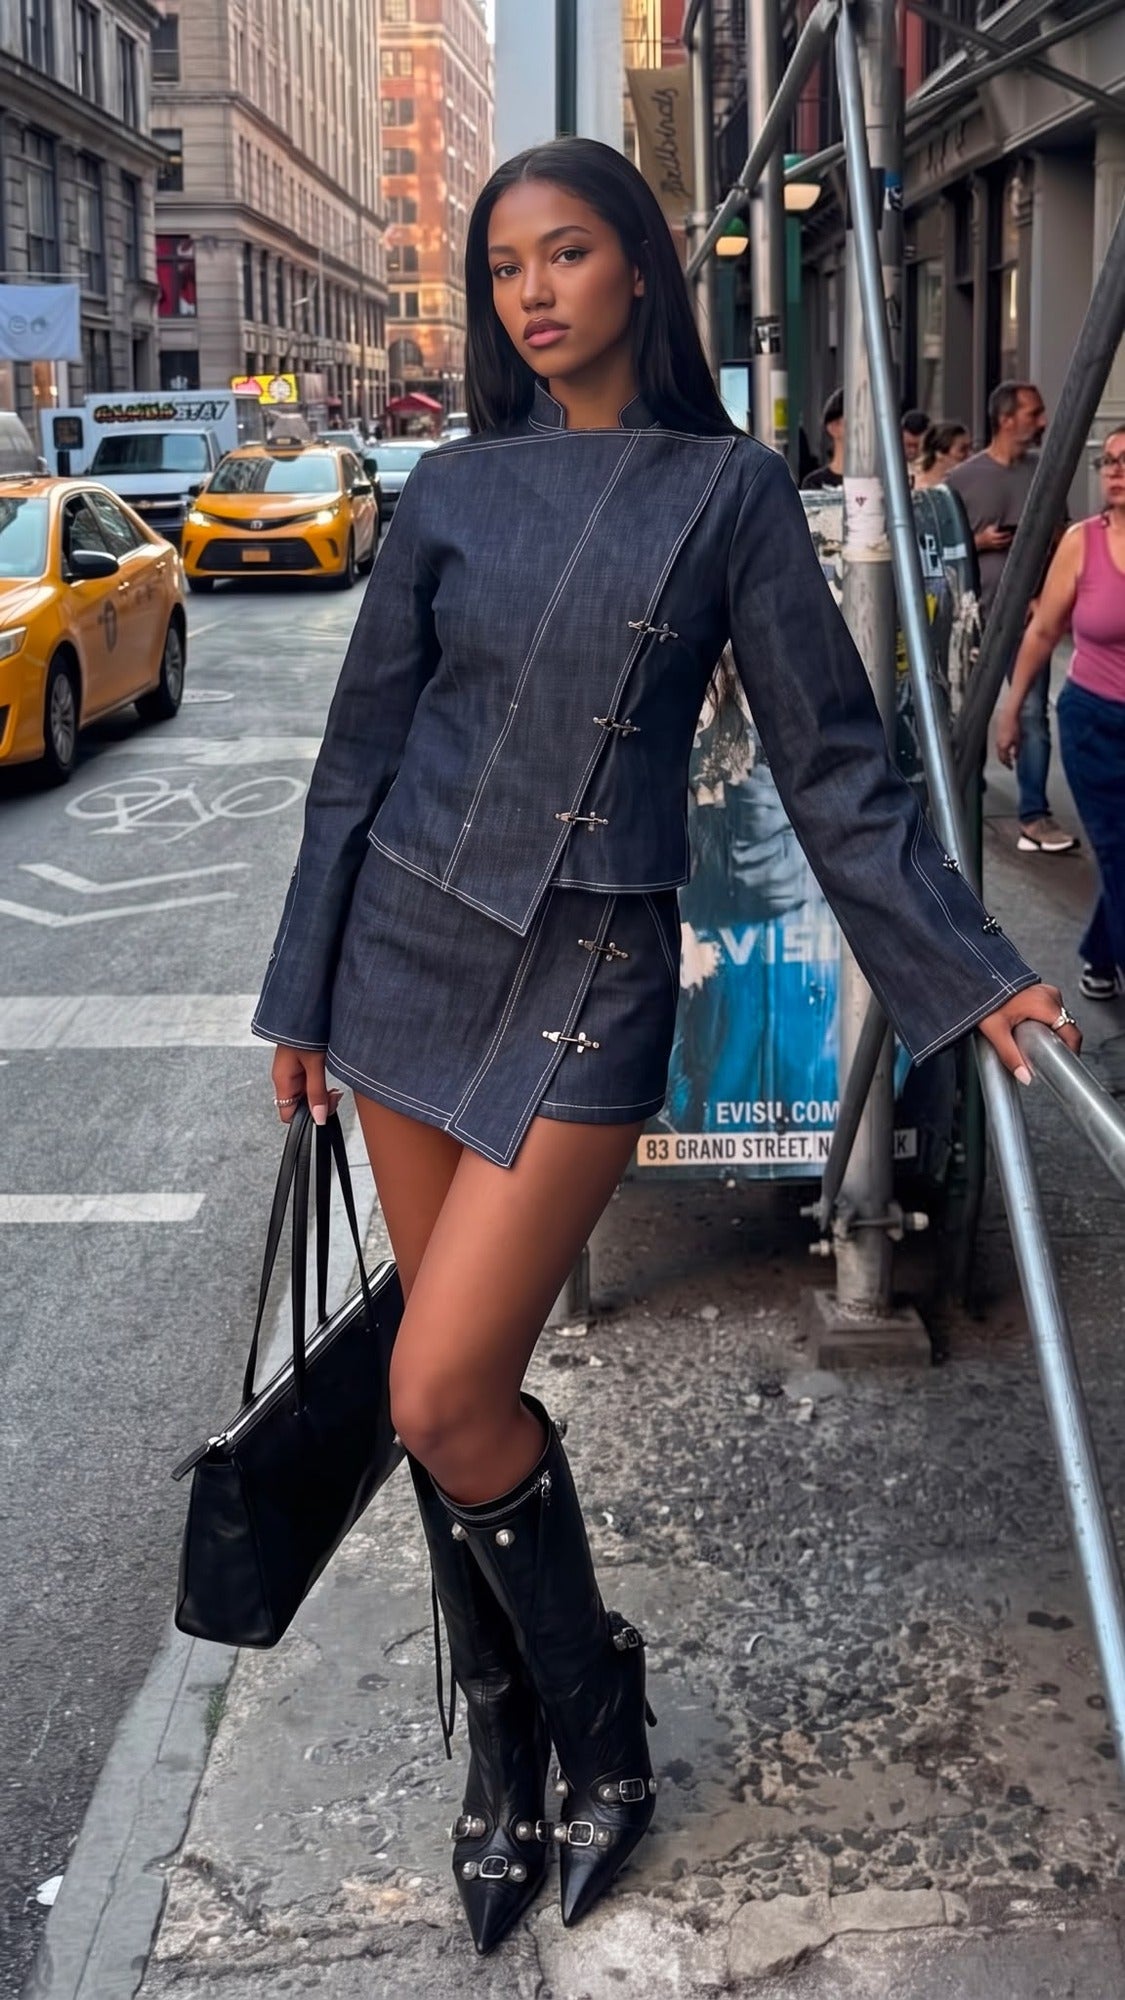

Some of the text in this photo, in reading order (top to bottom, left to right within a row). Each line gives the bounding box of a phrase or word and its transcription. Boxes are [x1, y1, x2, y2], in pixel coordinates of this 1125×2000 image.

[718, 925, 841, 965] VISU
[716, 1100, 841, 1124] EVISU.COM
[646, 1140, 669, 1160] 83
[675, 1138, 736, 1160] GRAND
[742, 1137, 813, 1160] STREET,
